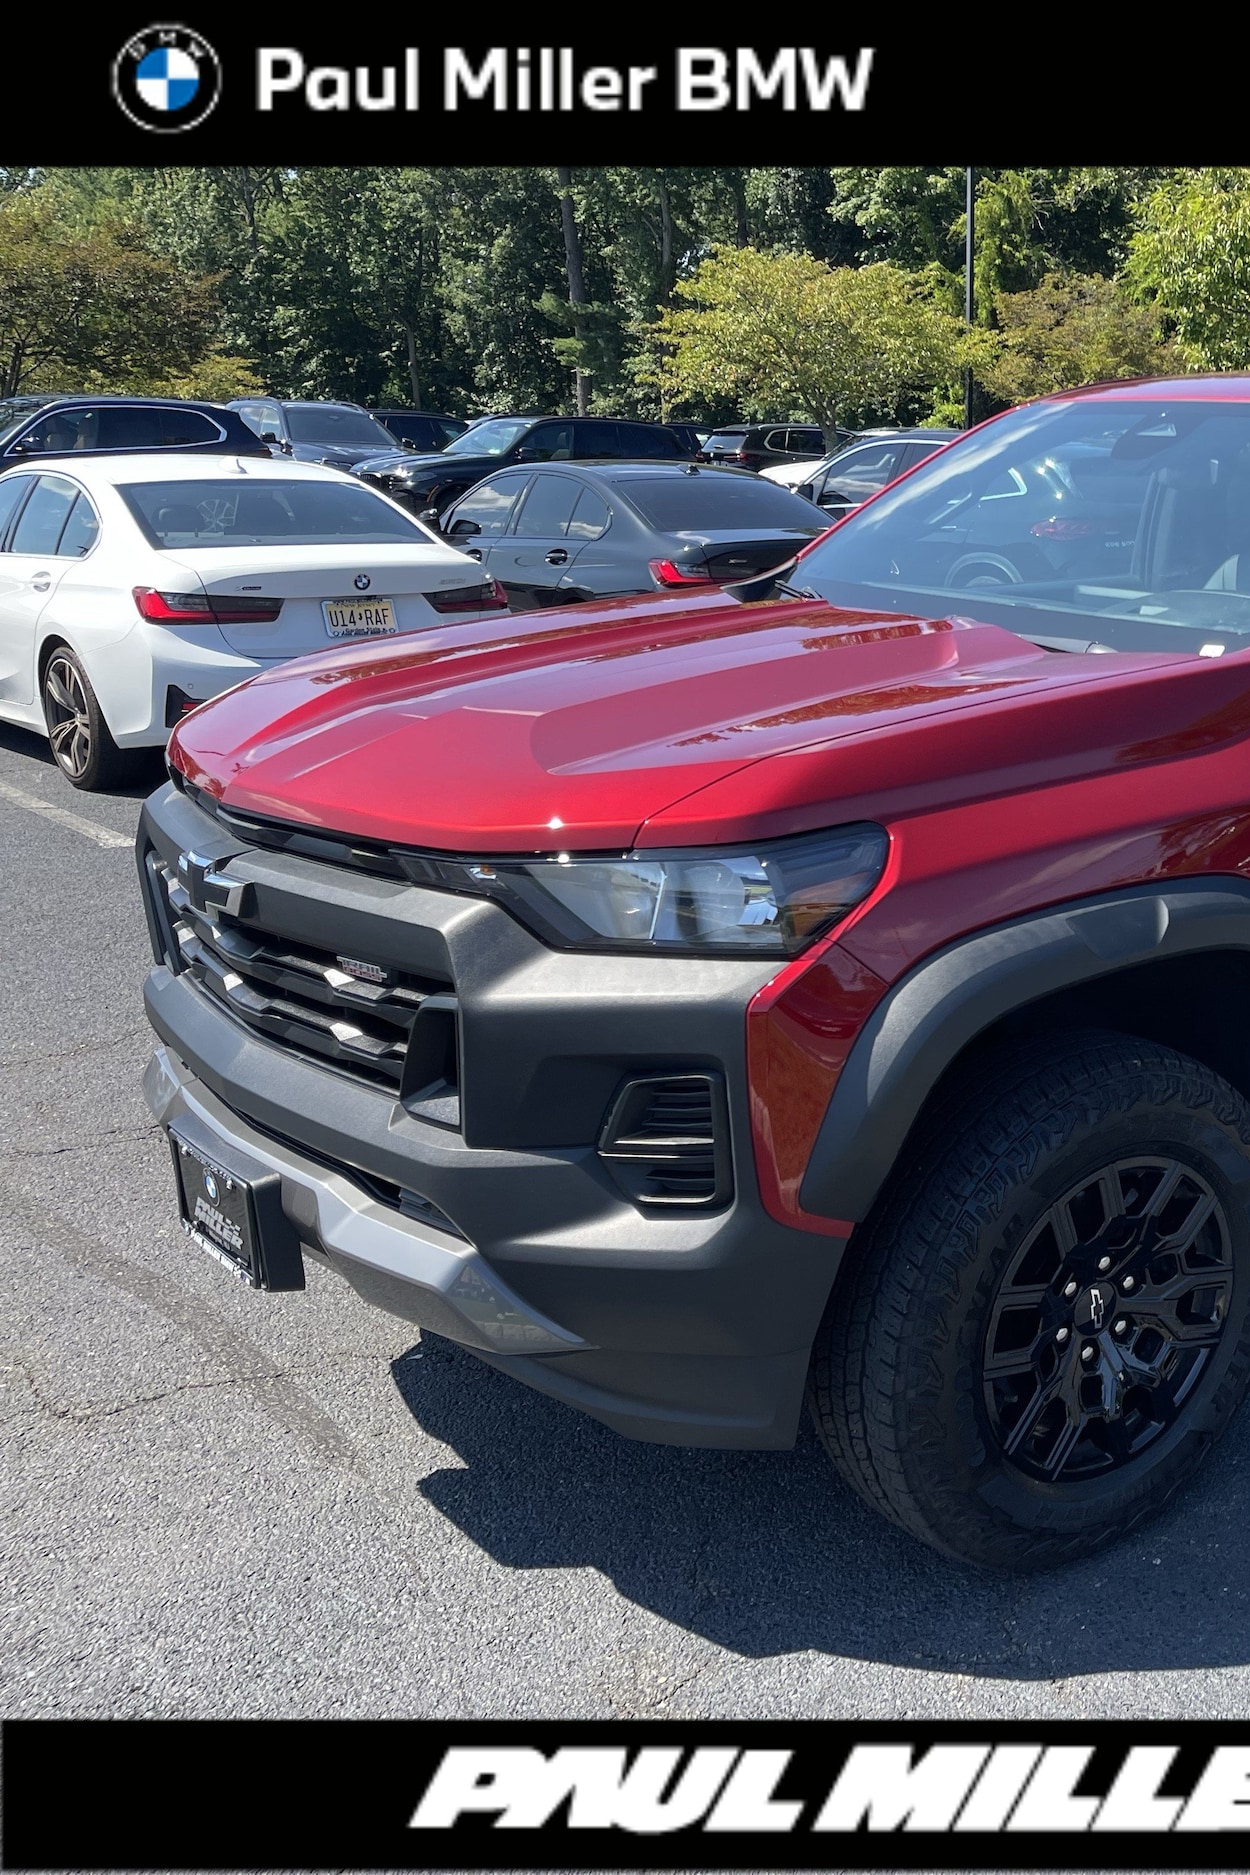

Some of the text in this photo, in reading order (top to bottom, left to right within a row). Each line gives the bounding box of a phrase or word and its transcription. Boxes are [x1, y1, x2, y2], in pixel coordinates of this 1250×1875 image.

[336, 955, 387, 978] TRAIL
[343, 965, 382, 982] BOSS
[194, 1206, 244, 1250] MILLER
